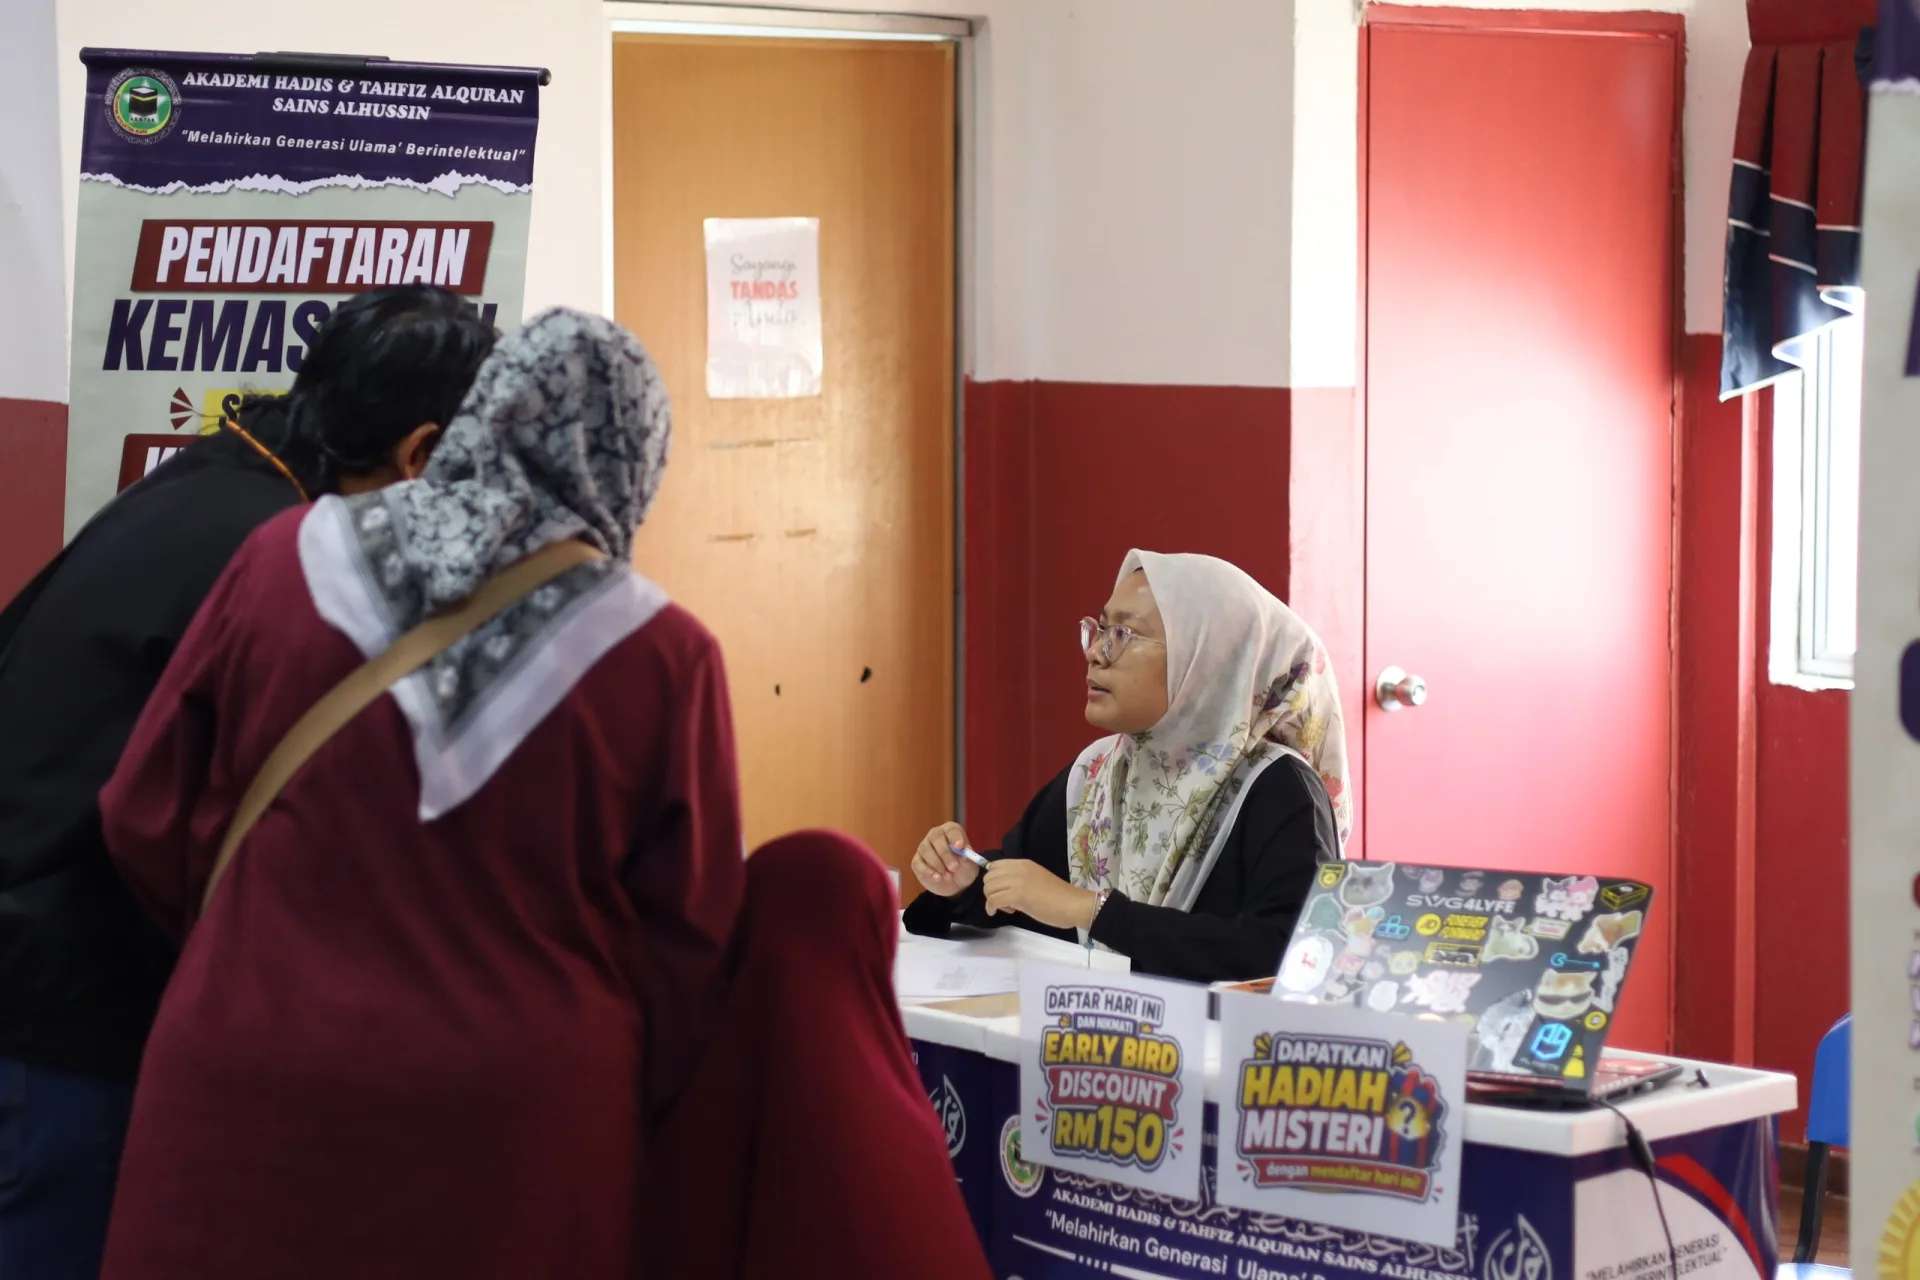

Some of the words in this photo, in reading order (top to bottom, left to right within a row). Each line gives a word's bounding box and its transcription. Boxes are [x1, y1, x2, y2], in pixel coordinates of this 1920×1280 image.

[183, 72, 270, 89] AKADEMI
[274, 76, 333, 92] HADIS
[338, 79, 354, 93] &
[359, 81, 427, 98] TAHFIZ
[431, 85, 525, 104] ALQURAN
[273, 98, 329, 114] SAINS
[333, 101, 431, 120] ALHUSSIN
[182, 129, 271, 147] "Melahirkan
[276, 135, 345, 151] Generasi
[350, 139, 403, 154] Ulama'
[406, 143, 526, 161] Berintelektual"
[155, 226, 471, 285] PENDAFTARAN
[730, 280, 798, 300] TANDAS
[1048, 990, 1100, 1010] DAFTAR
[1104, 993, 1137, 1017] HARI
[1141, 1001, 1162, 1022] INI
[1077, 1015, 1097, 1029] DAN
[1097, 1016, 1134, 1034] NIKMATI
[1044, 1032, 1119, 1065] EARLY
[1121, 1036, 1179, 1075] BIRD
[1277, 1039, 1386, 1068] DAPATKAN
[1058, 1070, 1167, 1110] DISCOUNT
[1242, 1065, 1389, 1112] HADIAH
[1054, 1105, 1165, 1162] RM150
[1242, 1109, 1385, 1157] MISTERI
[1266, 1162, 1308, 1180] dengan
[1310, 1164, 1373, 1182] mendaftar
[1374, 1168, 1399, 1186] hari
[1045, 1209, 1141, 1254] "Melahirkan
[1144, 1236, 1228, 1275] Generasi
[1053, 1187, 1114, 1214] AKADEMI
[1116, 1205, 1161, 1227] HADIS
[1163, 1217, 1176, 1231] &
[1179, 1220, 1235, 1244] TAHFIZ
[1236, 1234, 1321, 1261] ALQURAN
[1323, 1251, 1378, 1273] SAINS
[1671, 1233, 1720, 1259] ENERASI
